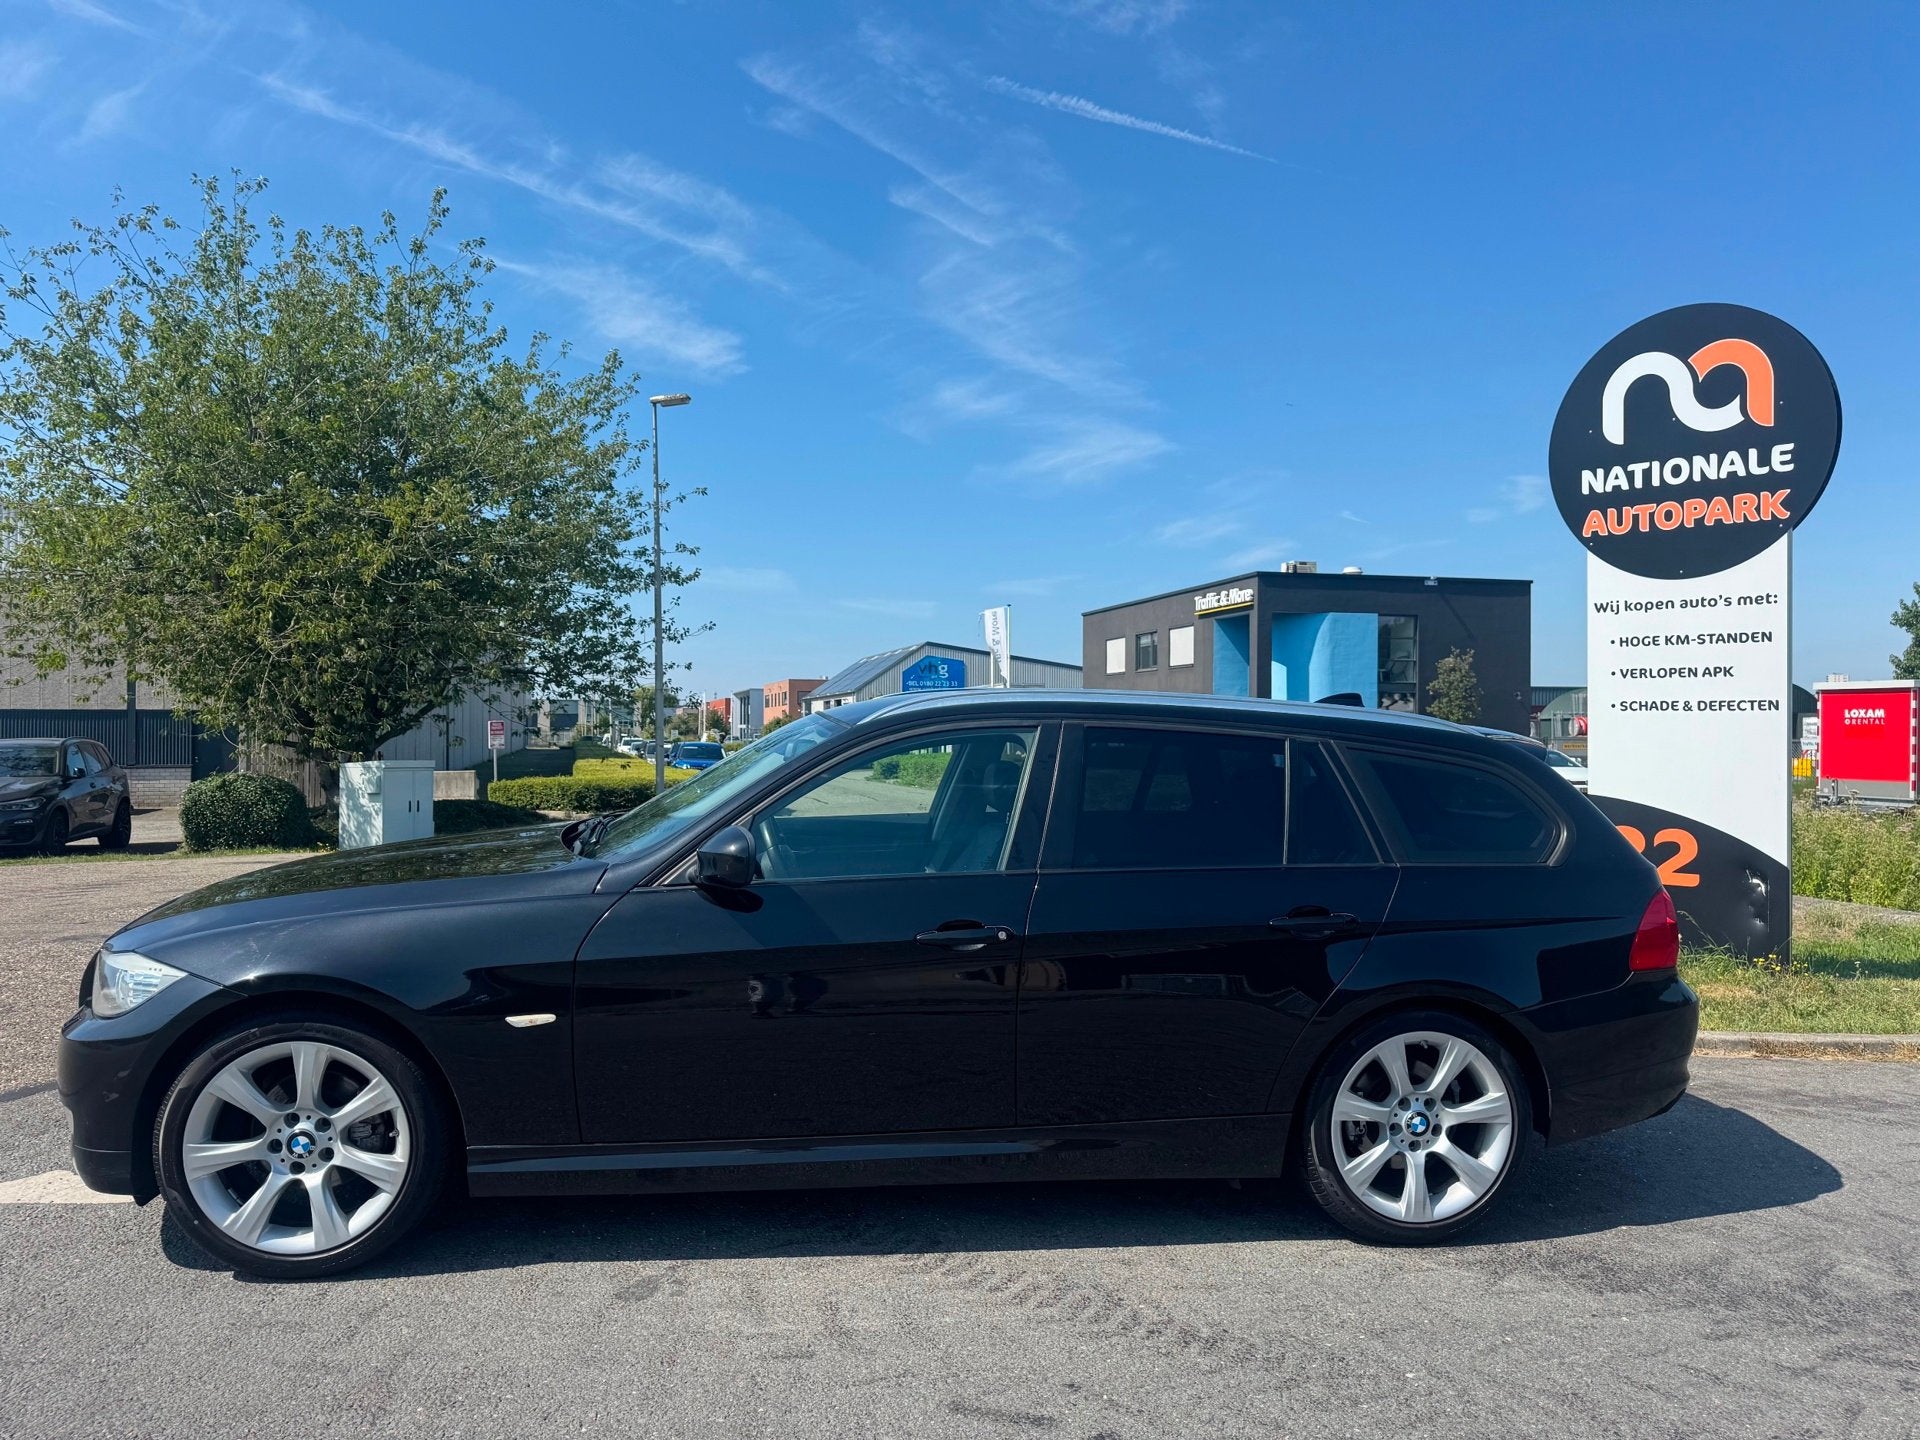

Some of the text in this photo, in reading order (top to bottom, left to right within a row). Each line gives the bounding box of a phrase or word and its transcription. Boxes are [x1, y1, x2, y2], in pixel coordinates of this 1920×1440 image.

[1581, 443, 1795, 495] NATIONALE
[1582, 488, 1791, 537] AUTOPARK
[1194, 588, 1254, 611] Traffic & More
[1594, 592, 1778, 615] Wij kopen auto's met:
[1619, 631, 1773, 647] HOGE KM-STANDEN
[1619, 666, 1734, 679] VERLOPEN APK
[1619, 699, 1780, 712] SCHADE & DEFECTEN
[1844, 709, 1885, 718] LOXAM
